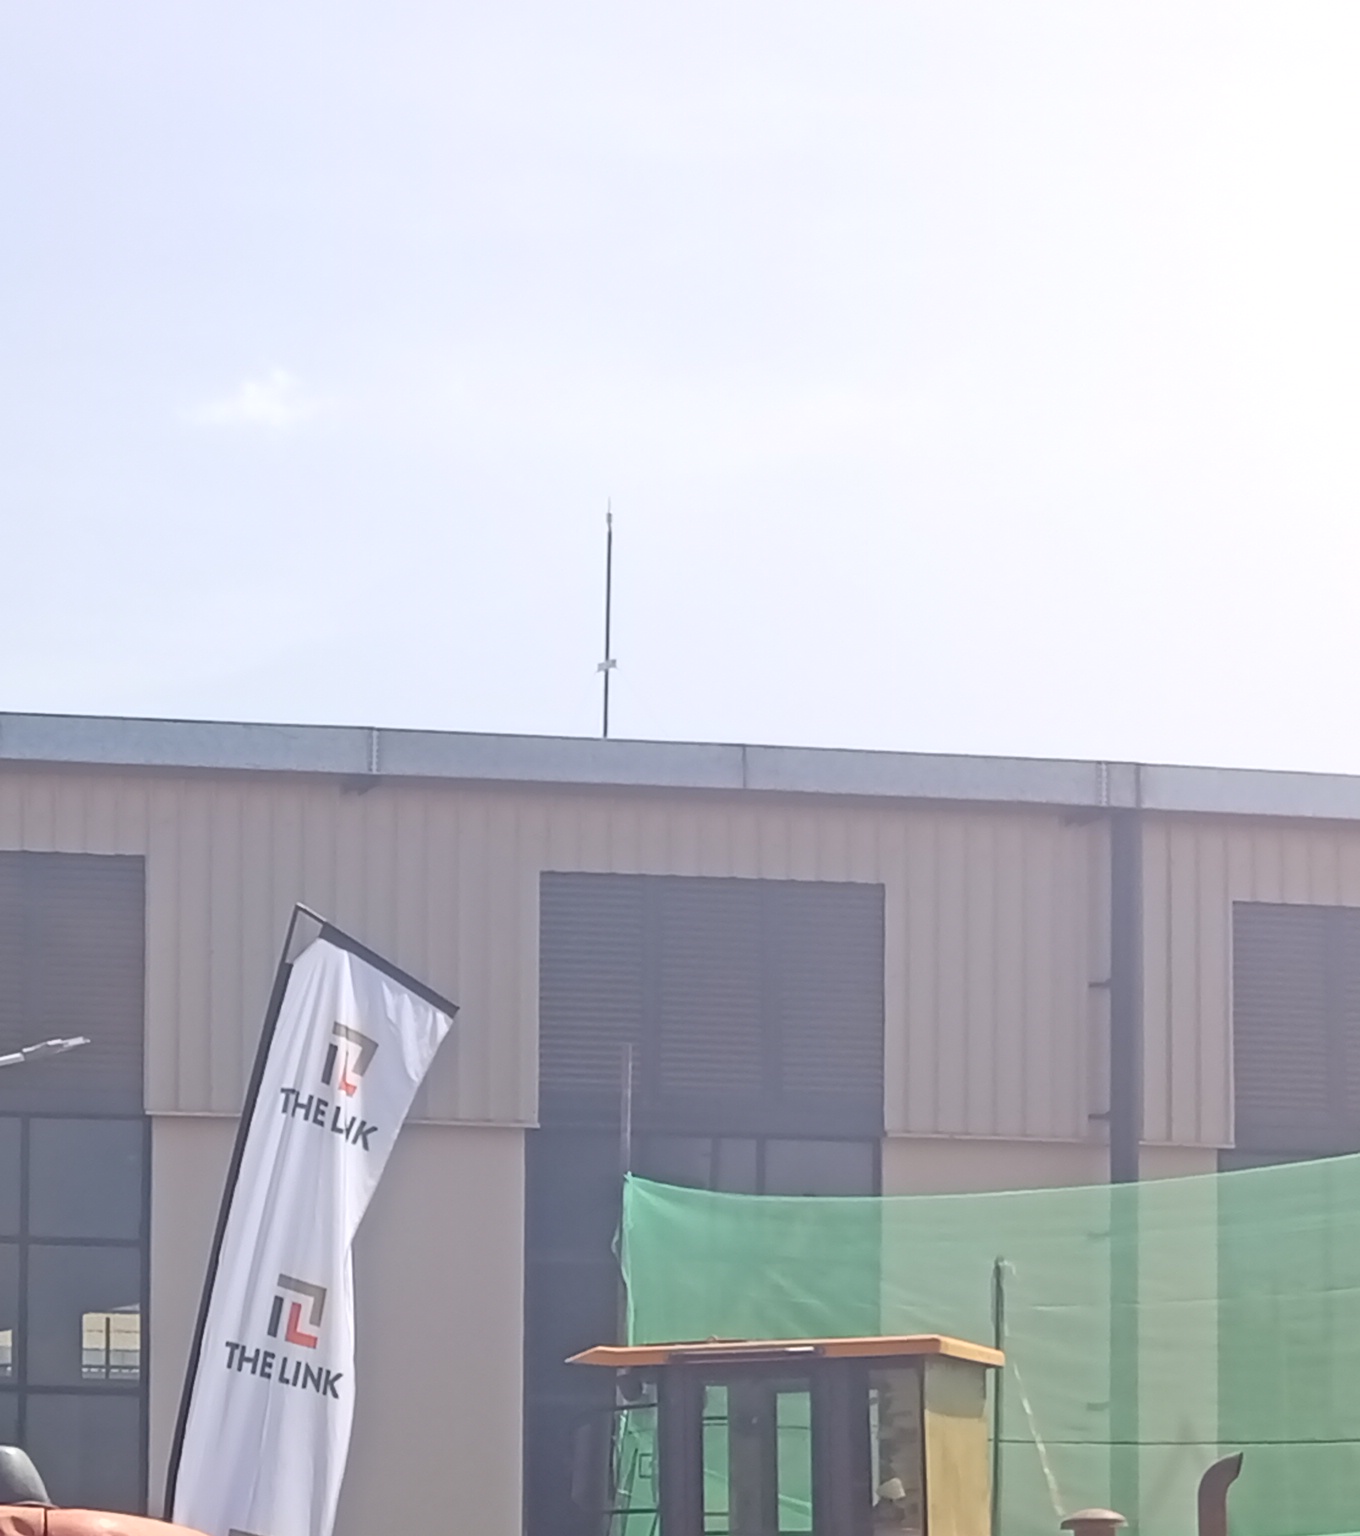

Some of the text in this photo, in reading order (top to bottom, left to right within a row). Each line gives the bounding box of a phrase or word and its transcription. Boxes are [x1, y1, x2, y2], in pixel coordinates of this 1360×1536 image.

[280, 1087, 378, 1152] THE LNK
[225, 1341, 343, 1399] THE LINK
